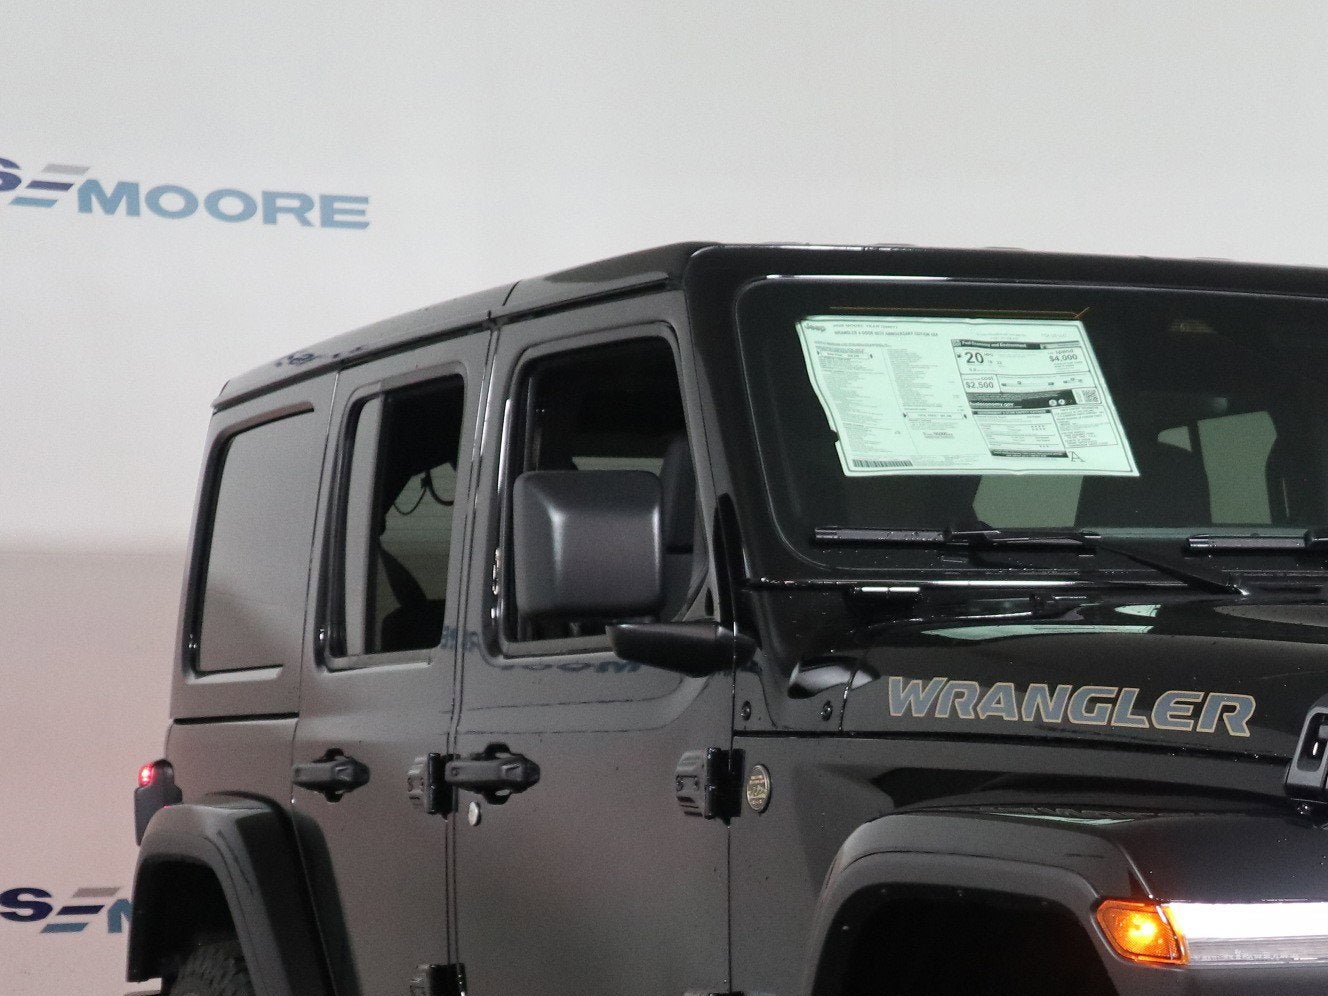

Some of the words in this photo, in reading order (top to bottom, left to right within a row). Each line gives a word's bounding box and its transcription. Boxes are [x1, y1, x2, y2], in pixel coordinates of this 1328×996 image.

[77, 178, 371, 231] MOORE
[964, 351, 985, 364] 20
[965, 381, 994, 390] $2,500
[888, 676, 1257, 738] WRANGLER
